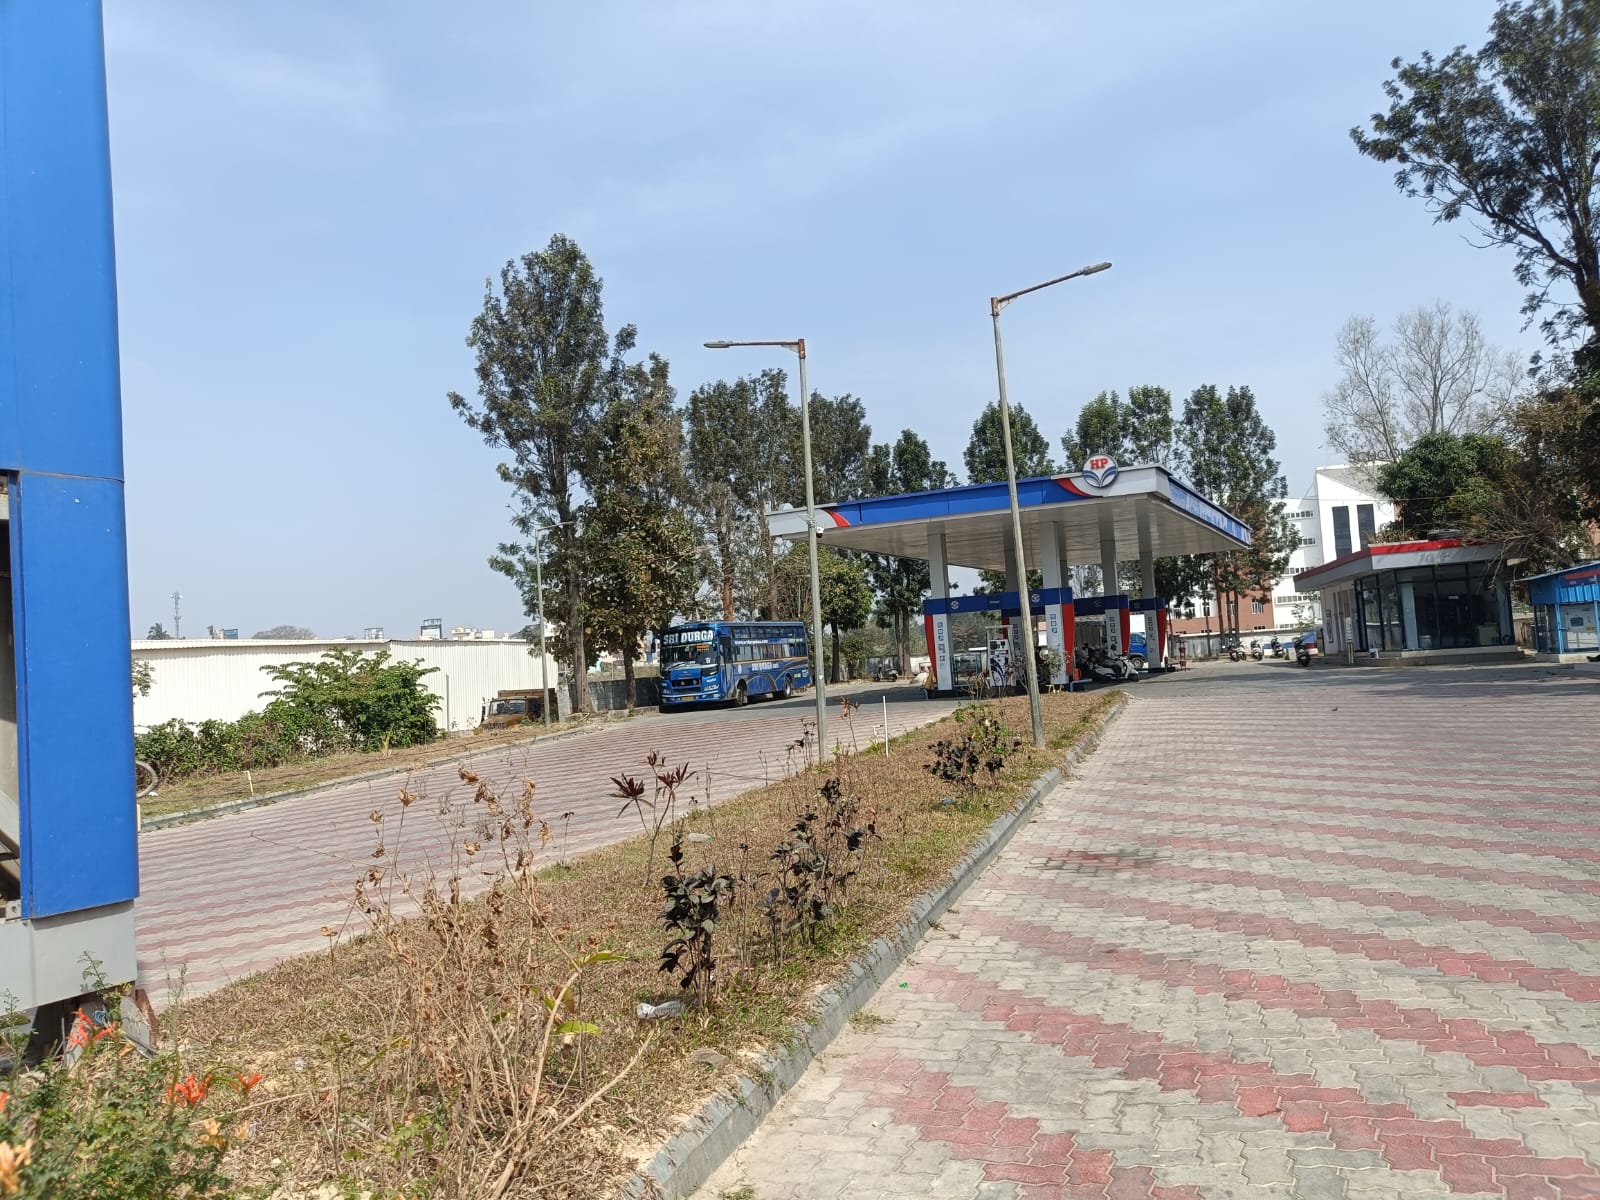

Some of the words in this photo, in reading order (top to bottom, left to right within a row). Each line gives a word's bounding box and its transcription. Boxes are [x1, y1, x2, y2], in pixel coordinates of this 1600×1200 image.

[1090, 457, 1109, 470] HP
[663, 633, 679, 645] SRI
[680, 630, 714, 644] DURGA
